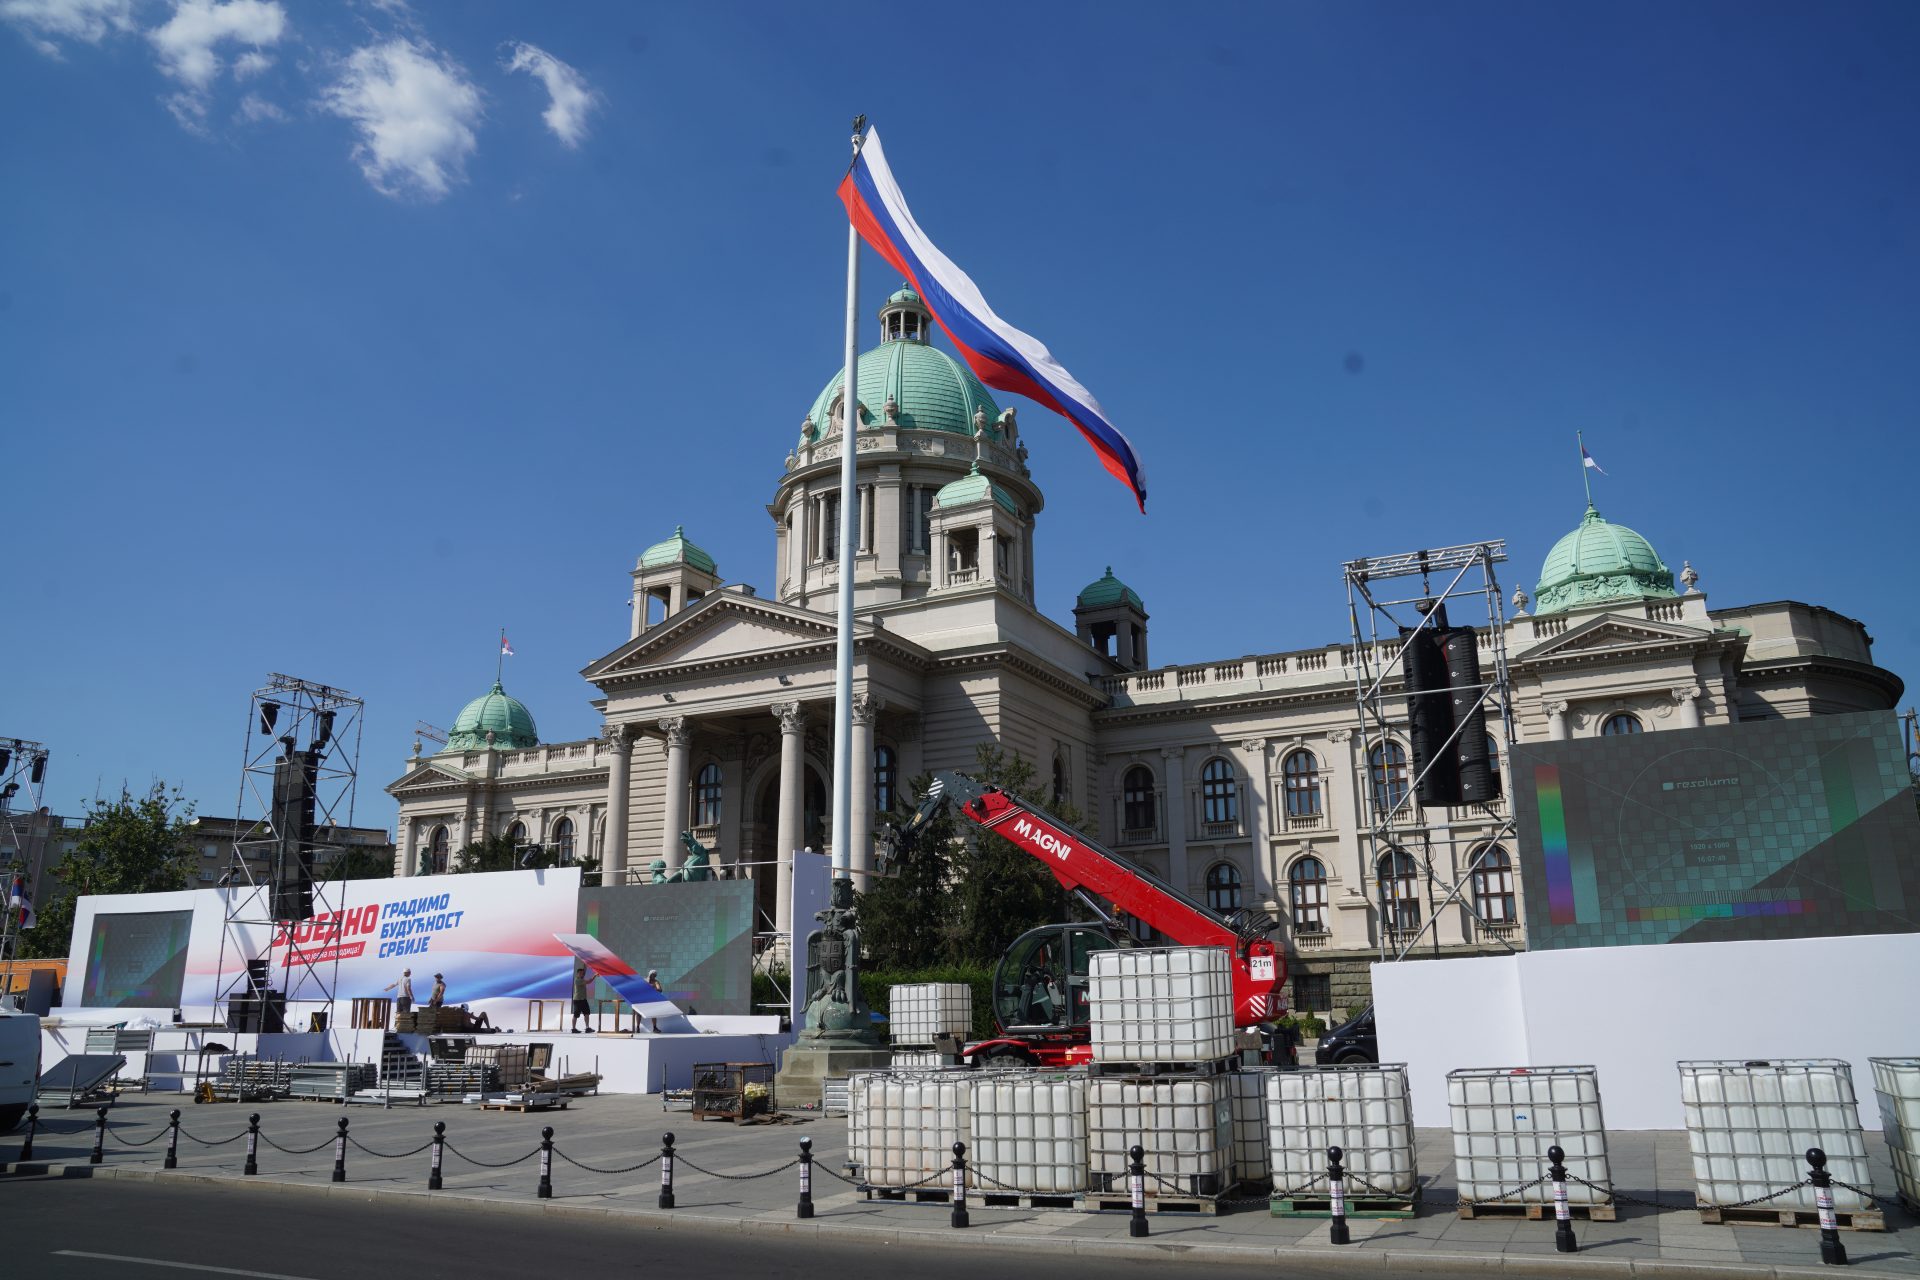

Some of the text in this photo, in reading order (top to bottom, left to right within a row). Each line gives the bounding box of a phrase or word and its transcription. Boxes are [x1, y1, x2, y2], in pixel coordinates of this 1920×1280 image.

[1676, 777, 1739, 789] resolume
[1013, 819, 1072, 861] MAGNI
[382, 893, 450, 919] ГРАДИМО
[272, 904, 379, 947] ЗАЈЕДНО
[380, 911, 464, 939] БУДУЋНОСТ
[379, 936, 431, 958] СРБИЈЕ
[1252, 959, 1272, 968] 21m
